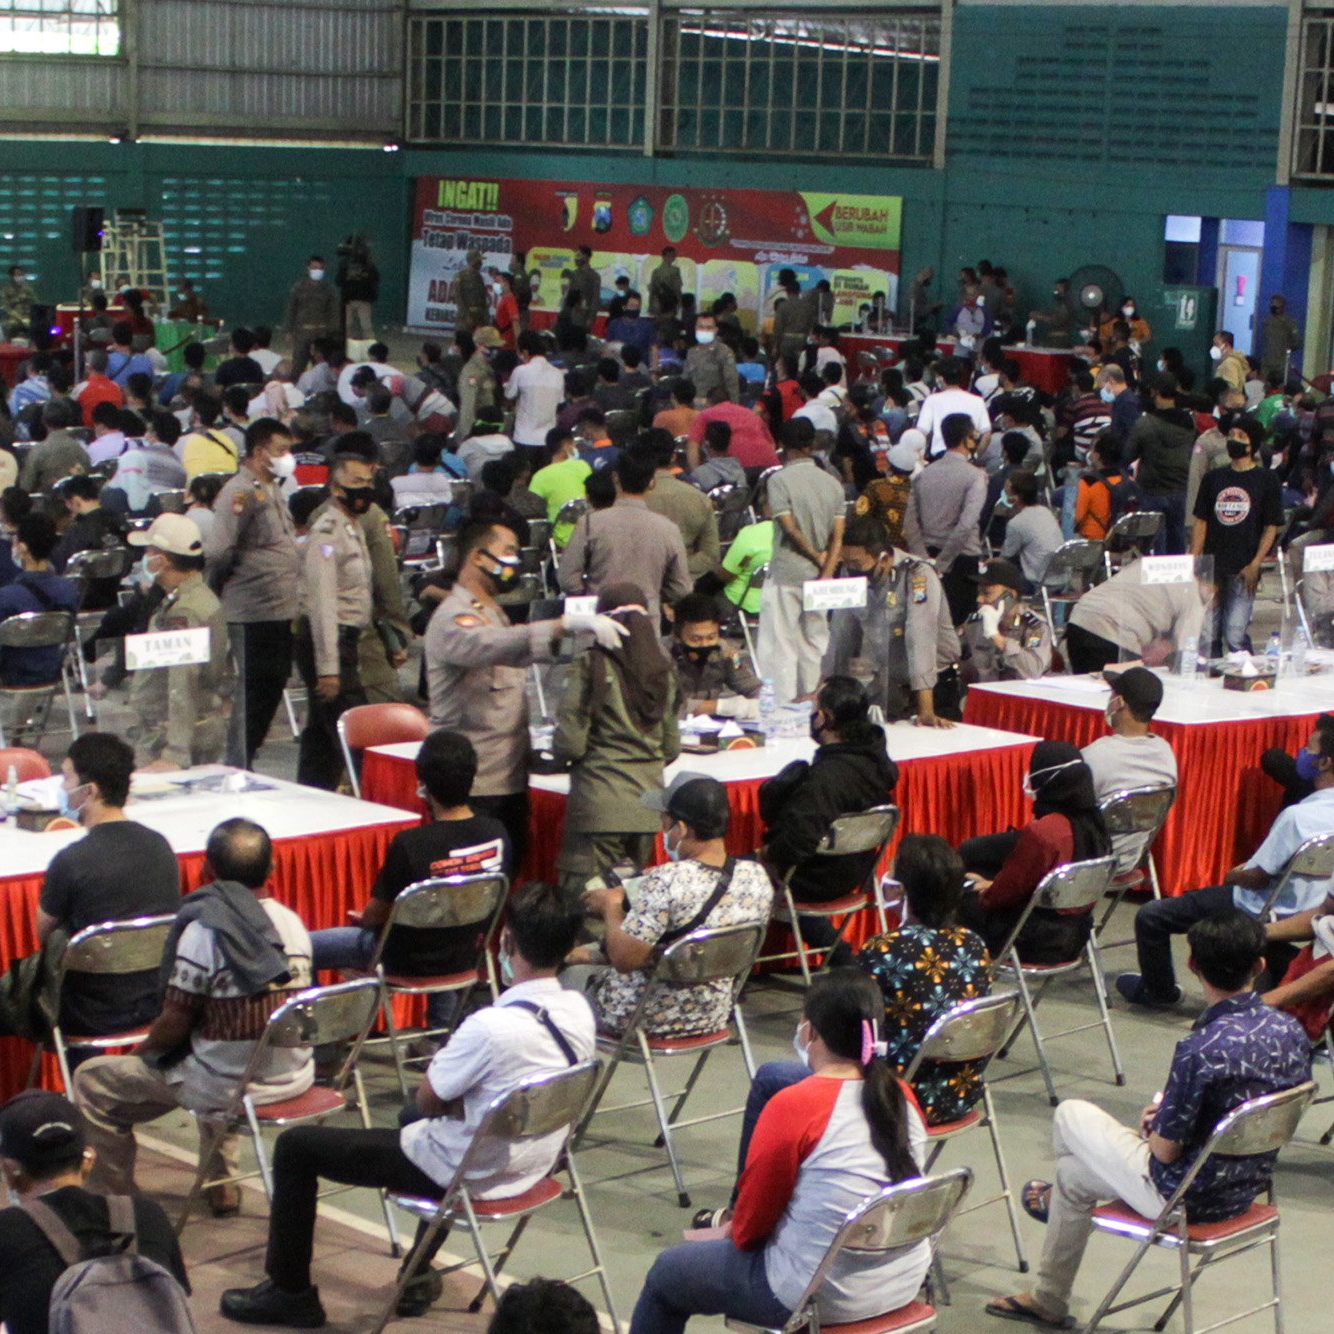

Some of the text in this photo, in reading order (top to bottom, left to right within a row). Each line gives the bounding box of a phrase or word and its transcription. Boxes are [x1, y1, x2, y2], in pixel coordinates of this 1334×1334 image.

[437, 179, 499, 211] INGAT!!
[834, 205, 889, 222] BERUBAH
[144, 637, 192, 653] TAMAN
